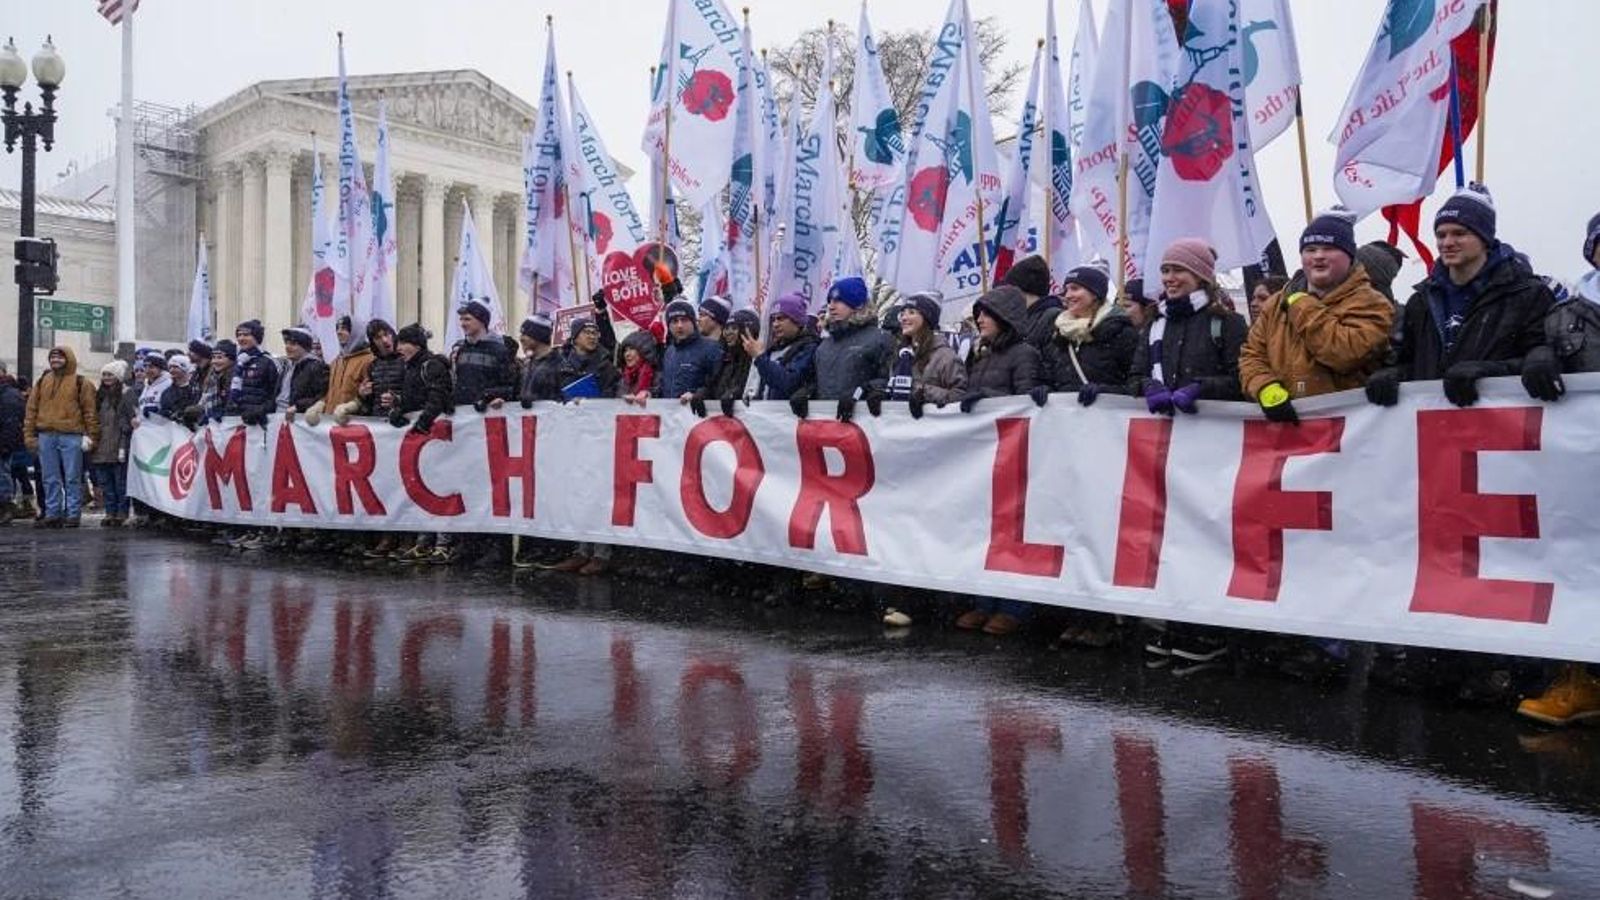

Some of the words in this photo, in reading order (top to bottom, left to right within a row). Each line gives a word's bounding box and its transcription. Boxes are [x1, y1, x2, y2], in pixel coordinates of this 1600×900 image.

[692, 0, 739, 43] arch
[794, 133, 820, 237] March
[604, 266, 639, 285] LOVE
[794, 250, 817, 281] for
[611, 281, 650, 302] BOTH
[204, 414, 538, 520] MARCH
[611, 414, 876, 557] FOR
[984, 406, 1555, 625] LIFE
